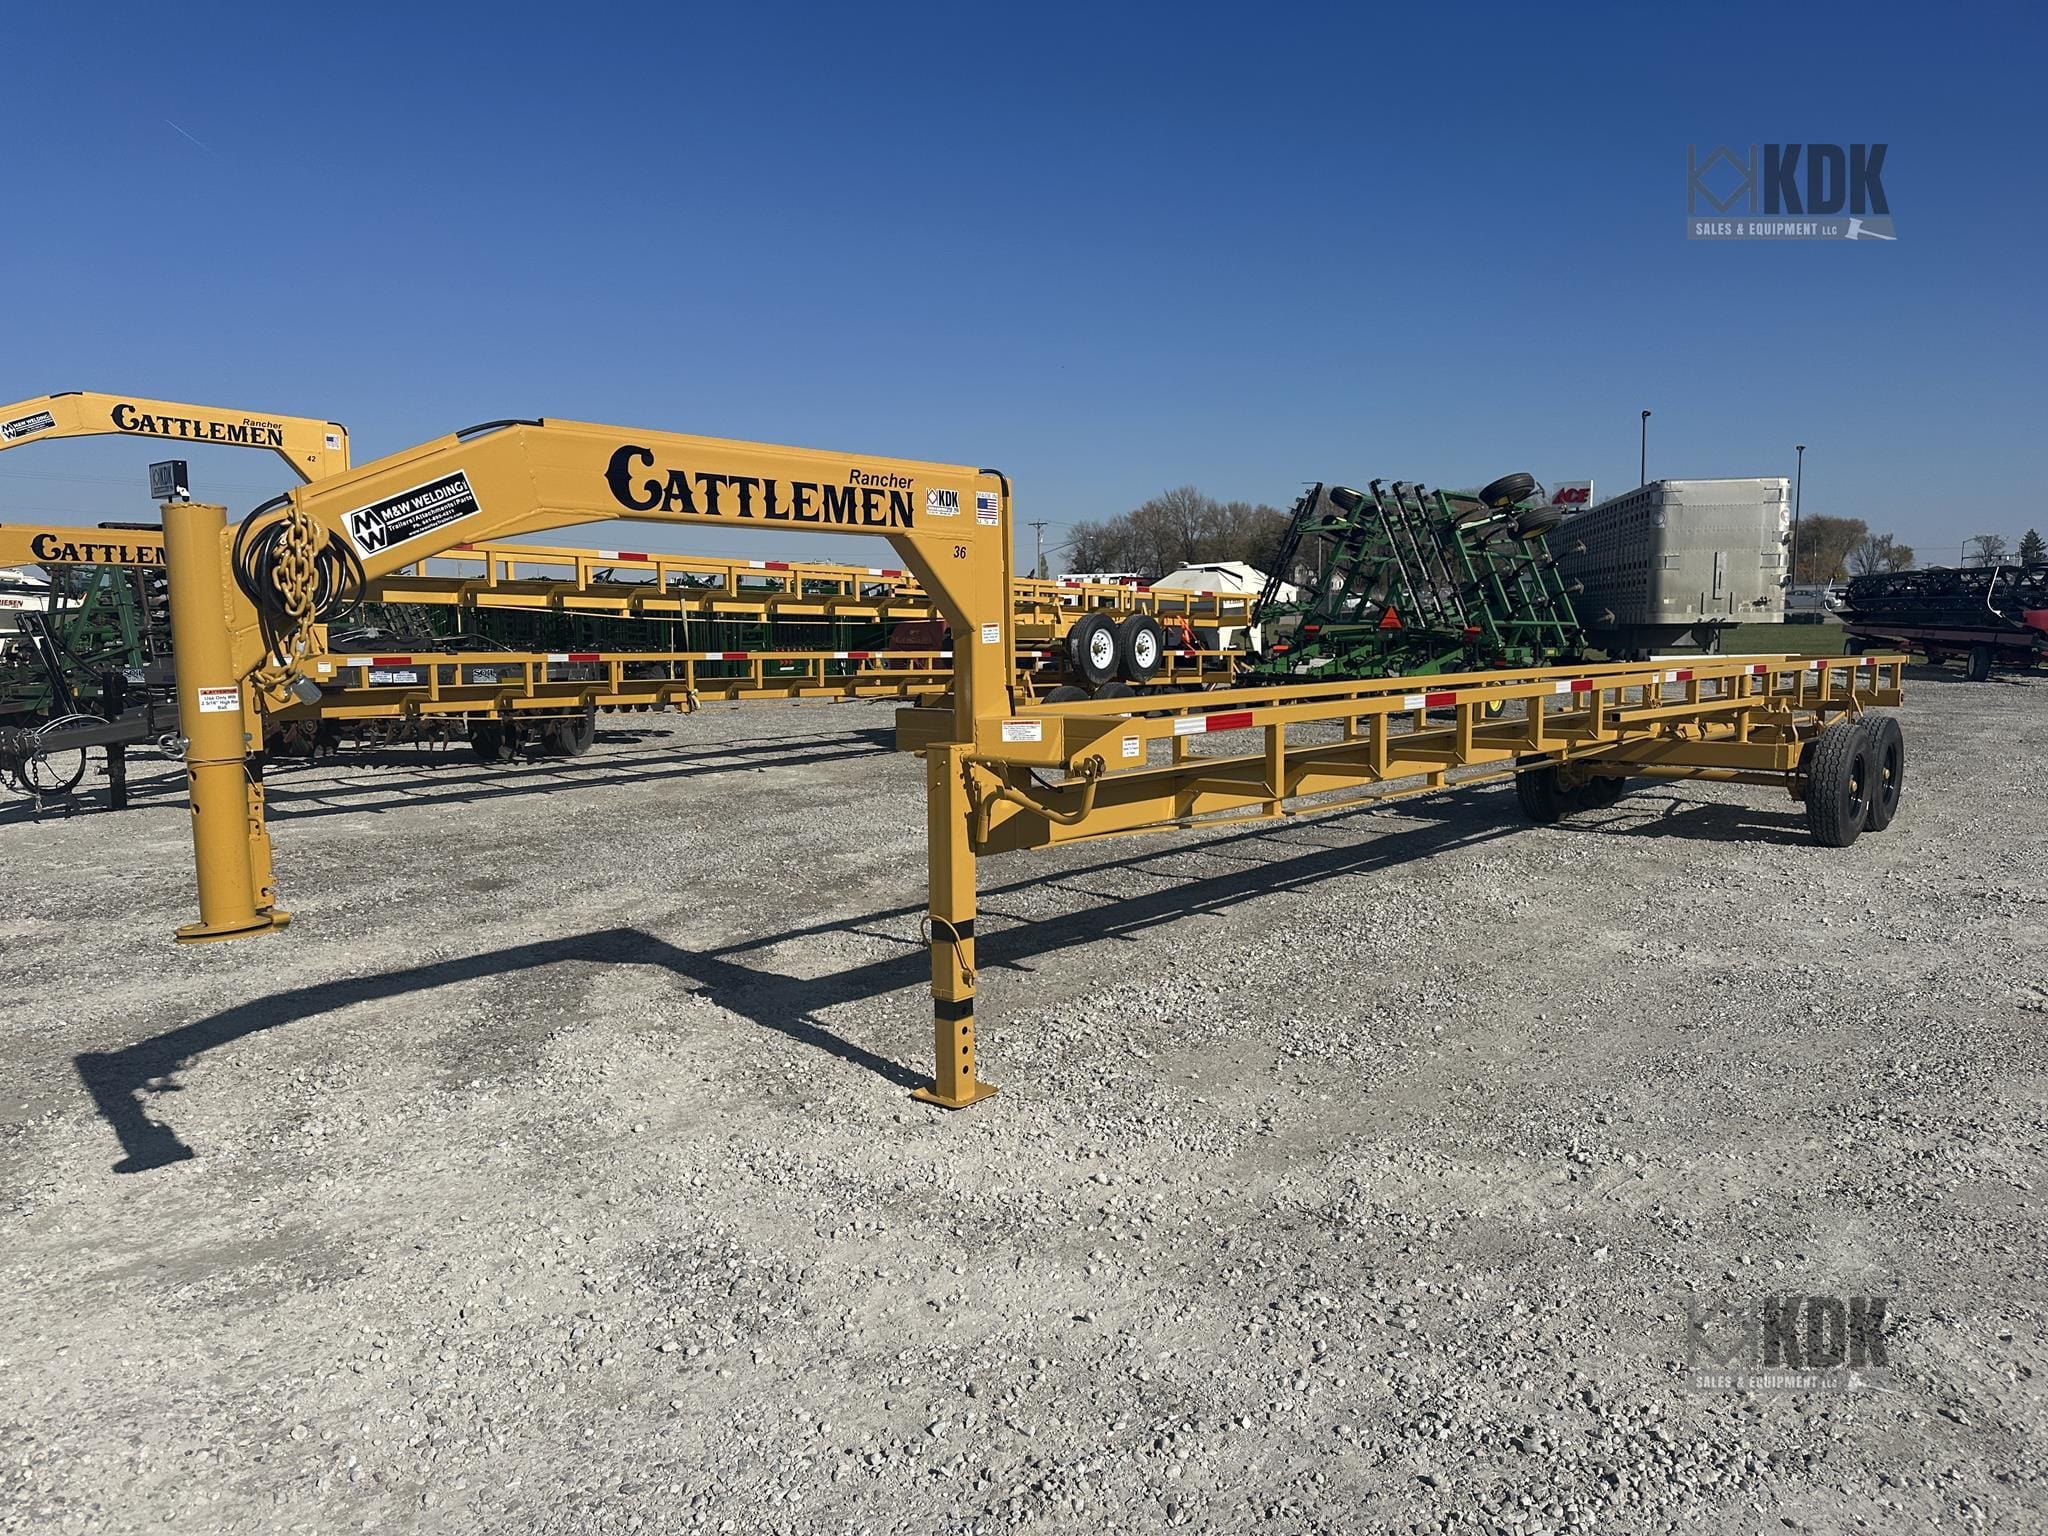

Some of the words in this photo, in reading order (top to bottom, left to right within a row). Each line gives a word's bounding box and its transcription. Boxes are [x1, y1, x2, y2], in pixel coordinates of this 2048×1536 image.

[110, 404, 283, 447] CATTLEMEN
[243, 418, 283, 430] Rancher
[604, 444, 915, 529] CATTLEMEN
[849, 469, 914, 489] Rancher
[381, 501, 411, 521] M&W
[411, 481, 464, 509] WELDING
[938, 490, 958, 507] KDK
[1552, 487, 1590, 505] ACE
[388, 519, 413, 532] Trailers
[415, 503, 454, 520] Attachments
[456, 495, 473, 506] Parts
[953, 545, 967, 559] 36
